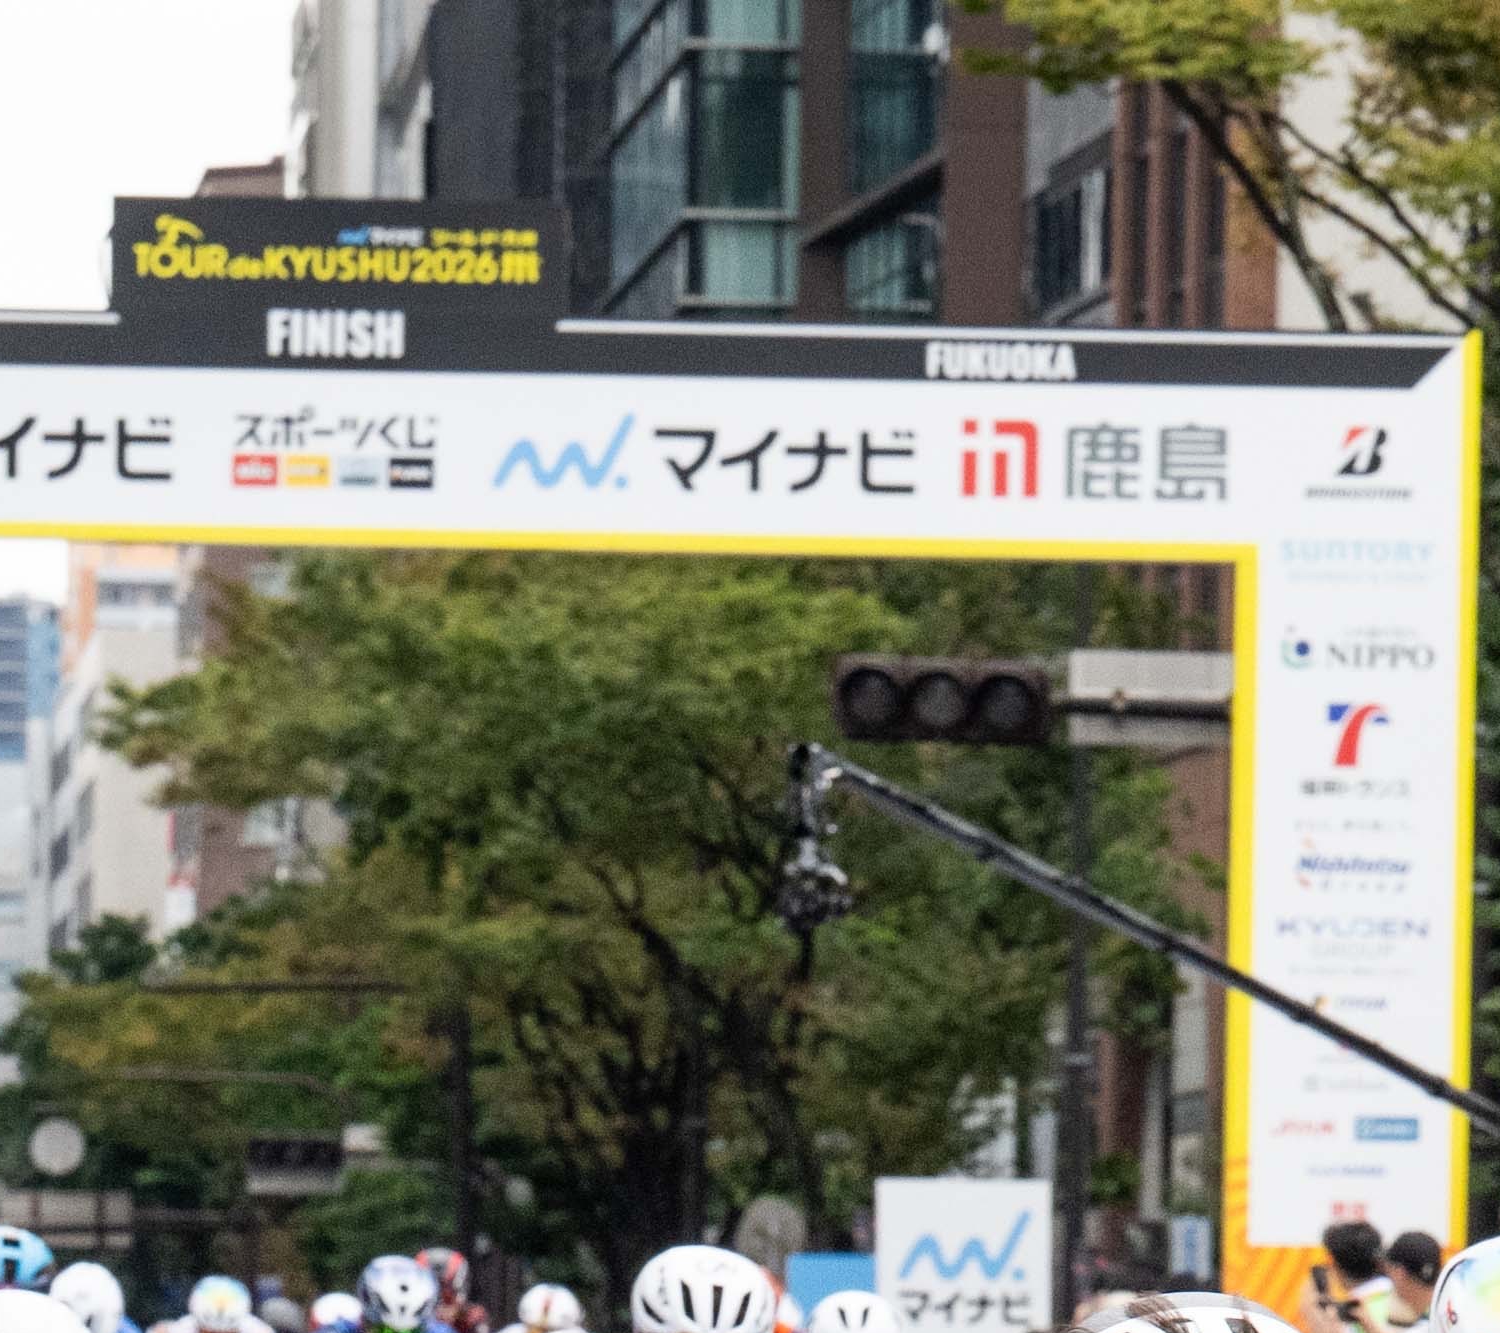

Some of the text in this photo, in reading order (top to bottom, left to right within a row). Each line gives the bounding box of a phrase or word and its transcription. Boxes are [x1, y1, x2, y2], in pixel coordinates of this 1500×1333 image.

[266, 308, 406, 359] FINISH
[925, 341, 1077, 382] FUKUOKA
[234, 404, 437, 449] スポーツくじ
[651, 425, 916, 495] マイナビ
[1065, 421, 1230, 502] 鹿島
[1326, 642, 1436, 671] NIPPO
[1276, 917, 1430, 939] KYUDEN
[898, 1288, 1034, 1327] マイナビ
